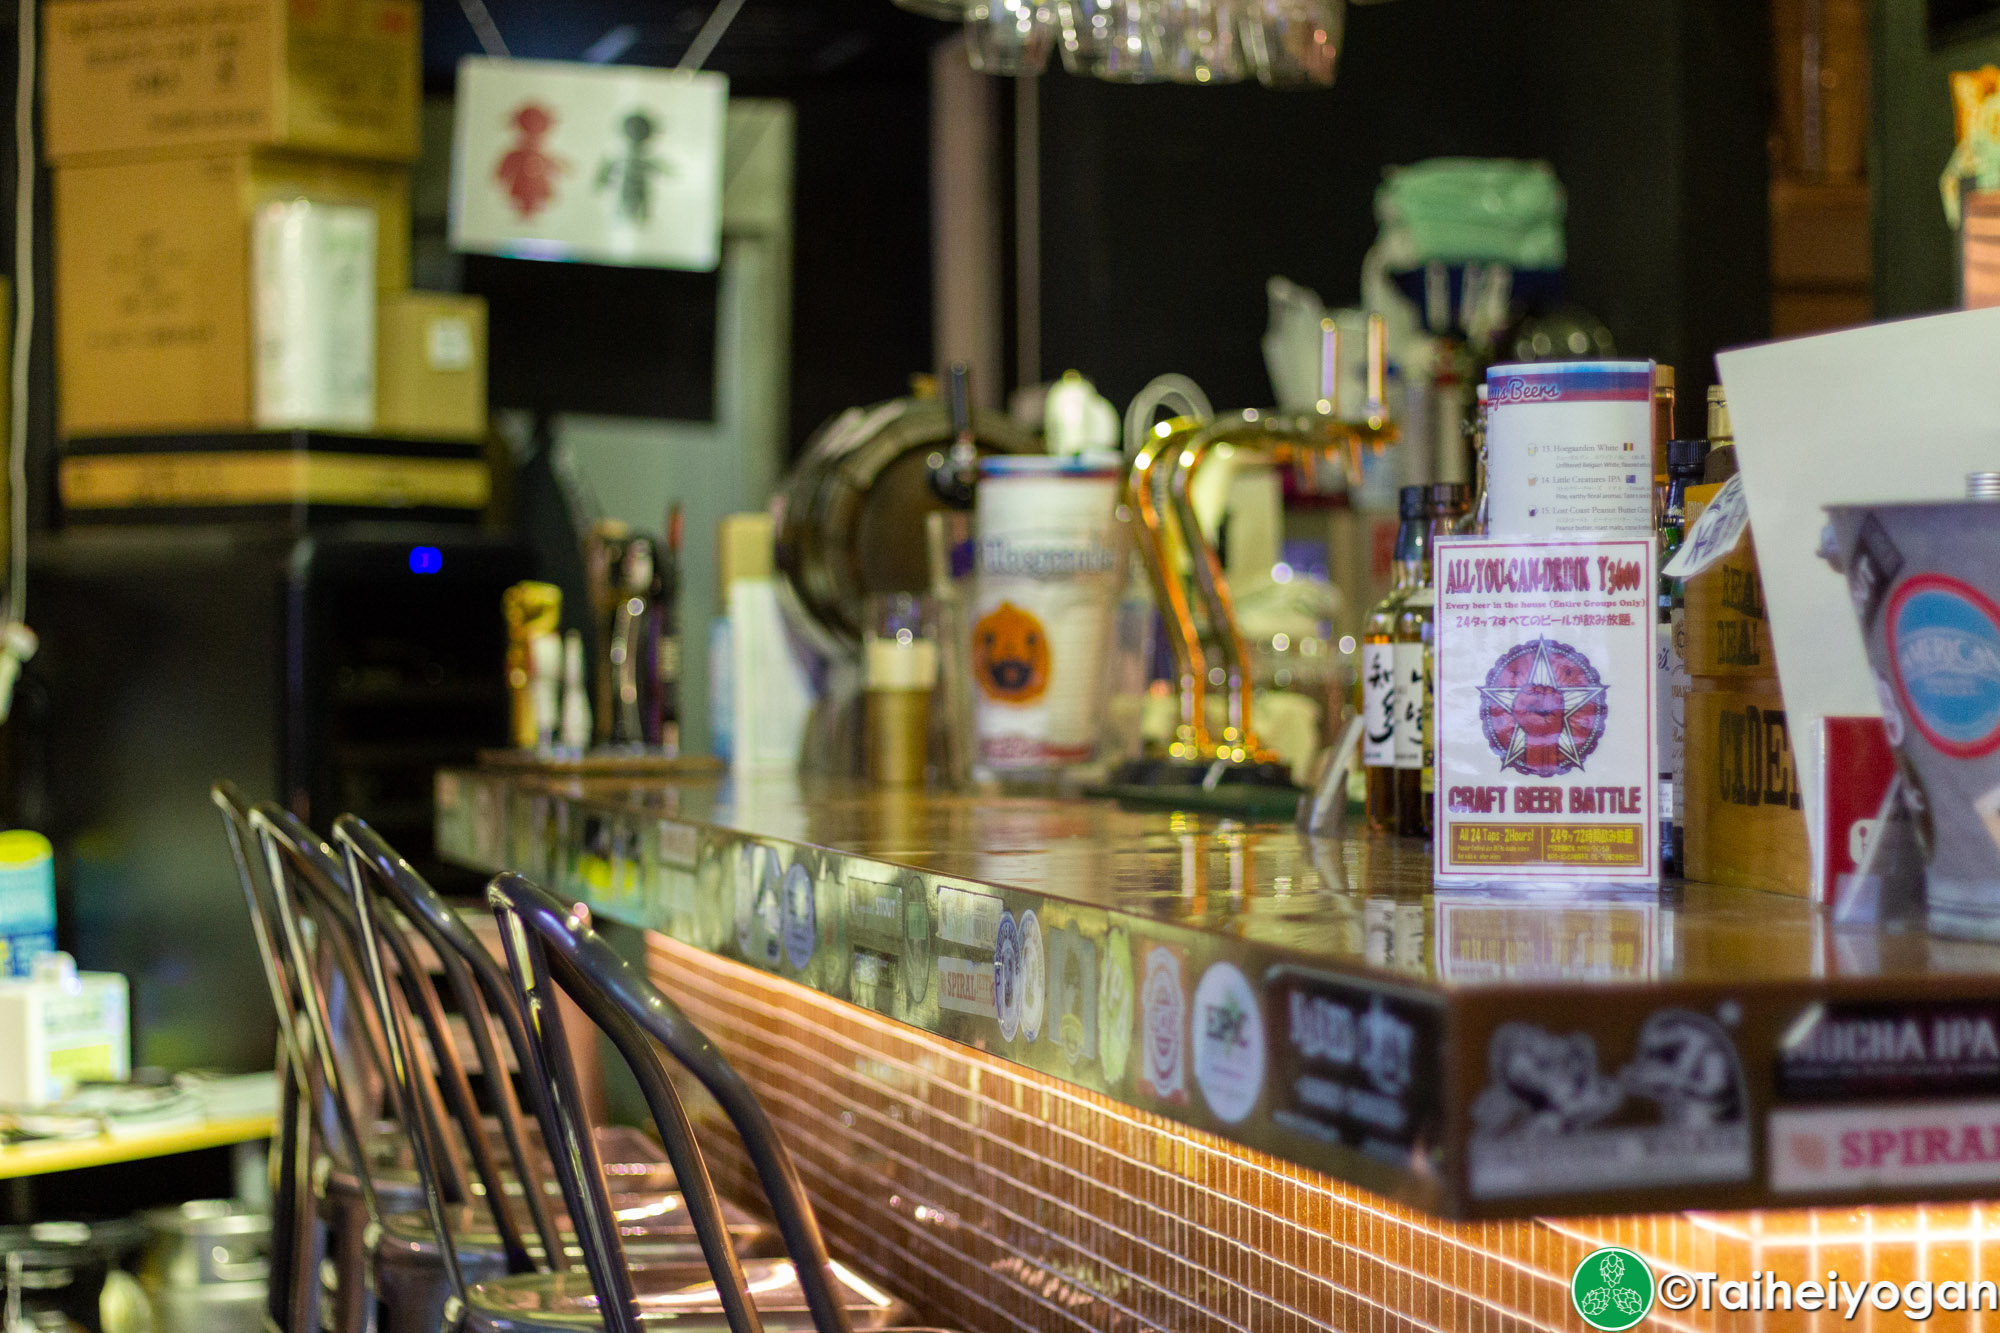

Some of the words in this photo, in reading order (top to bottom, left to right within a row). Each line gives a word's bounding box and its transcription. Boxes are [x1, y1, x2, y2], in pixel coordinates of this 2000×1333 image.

[1509, 377, 1559, 400] Beers
[1553, 444, 1595, 454] Hoegaarden
[1597, 443, 1619, 452] White
[1572, 475, 1606, 484] Creatures
[1608, 475, 1621, 483] IPA
[1592, 506, 1616, 514] Peanut
[1446, 556, 1591, 595] ALL-YOU-CAN-DRINK
[1445, 602, 1470, 611] Every
[1472, 601, 1491, 609] beer
[1493, 601, 1502, 609] in
[1504, 601, 1519, 609] the
[1521, 601, 1547, 609] house
[1549, 600, 1581, 609] (Entire
[1583, 600, 1617, 610] Groups
[1619, 599, 1646, 609] Only)
[1448, 786, 1508, 814] CRAFT
[1513, 786, 1564, 814] BEER
[1569, 786, 1642, 815] BATTLE
[1459, 828, 1469, 841] All
[1471, 828, 1481, 842] 24
[947, 971, 976, 1001] SPIRAL
[1934, 1017, 2000, 1060] IPA
[1840, 1122, 2000, 1169] SPIRA
